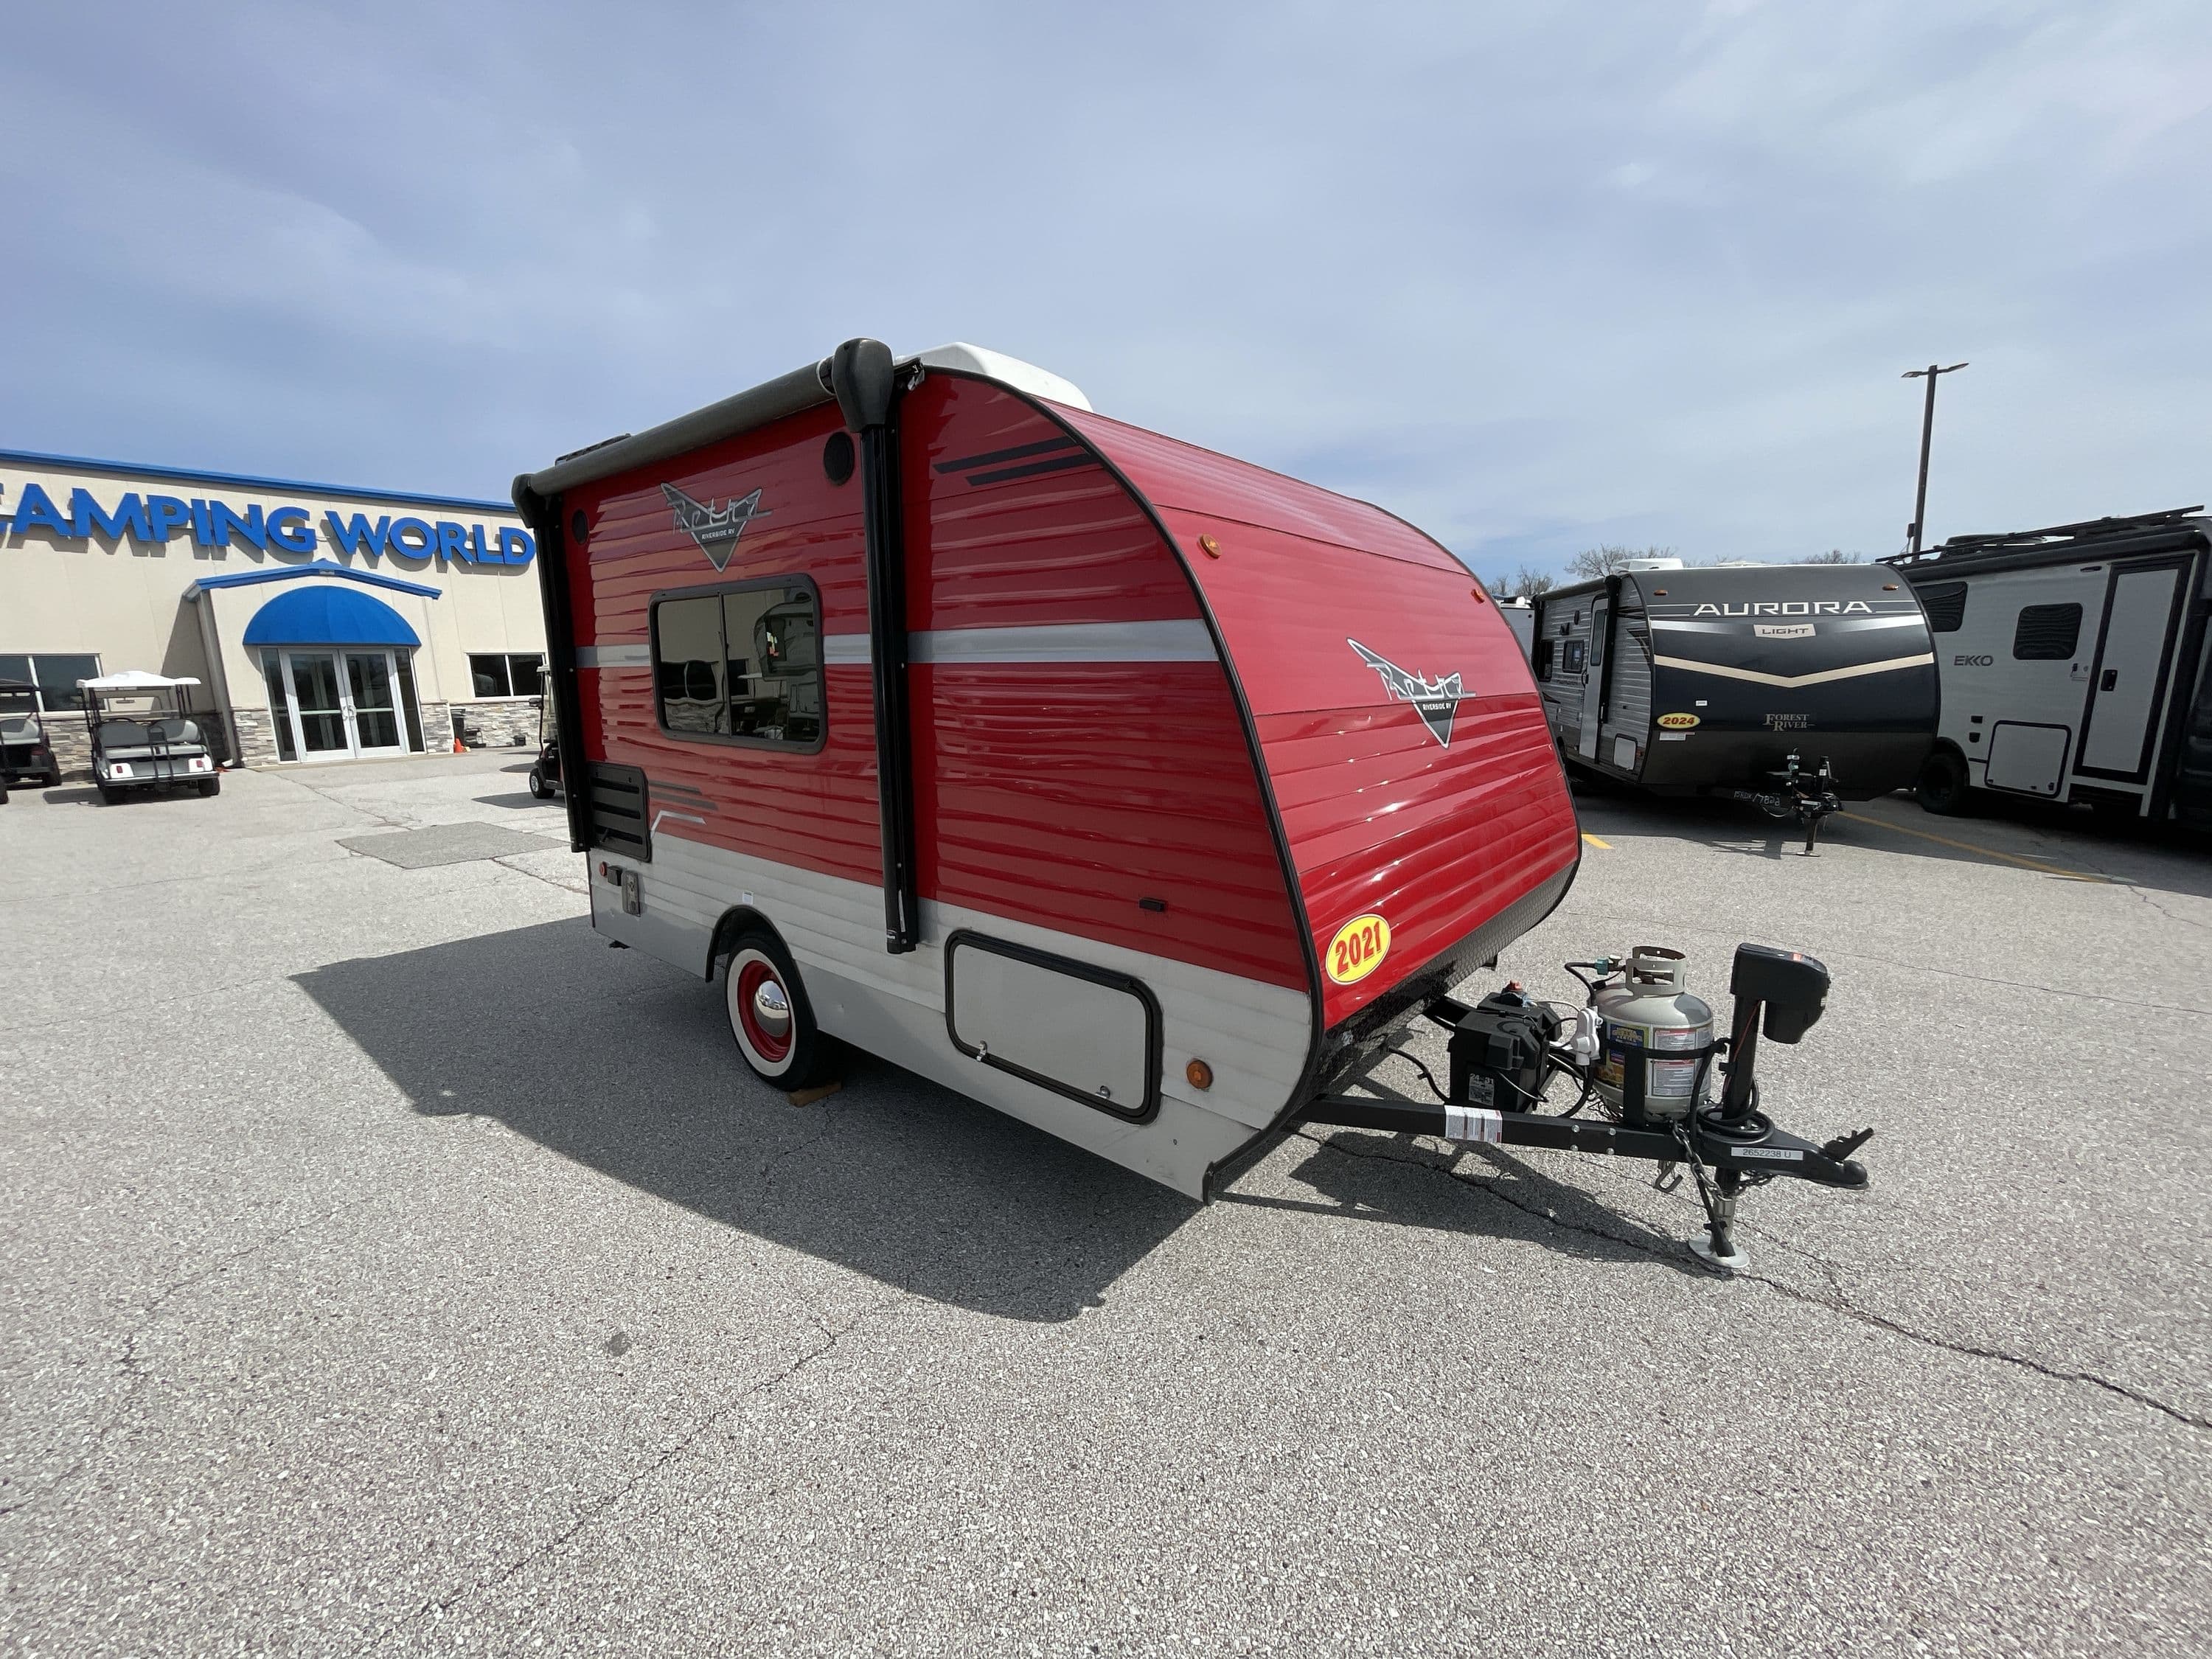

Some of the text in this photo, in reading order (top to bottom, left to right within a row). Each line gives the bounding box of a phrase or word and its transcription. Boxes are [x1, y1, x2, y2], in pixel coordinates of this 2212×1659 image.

[0, 482, 537, 566] AMPING WORLD
[701, 529, 727, 540] RIVERSIDE
[1694, 601, 1873, 616] AURORA
[1954, 655, 1994, 667] EKKO
[1422, 703, 1445, 711] RIVERSIDE
[1663, 717, 1695, 726] 2024
[1763, 714, 1809, 726] FOREST
[1774, 720, 1808, 731] RIVER
[1335, 921, 1382, 977] 2021
[1742, 1149, 1781, 1158] 2652238
